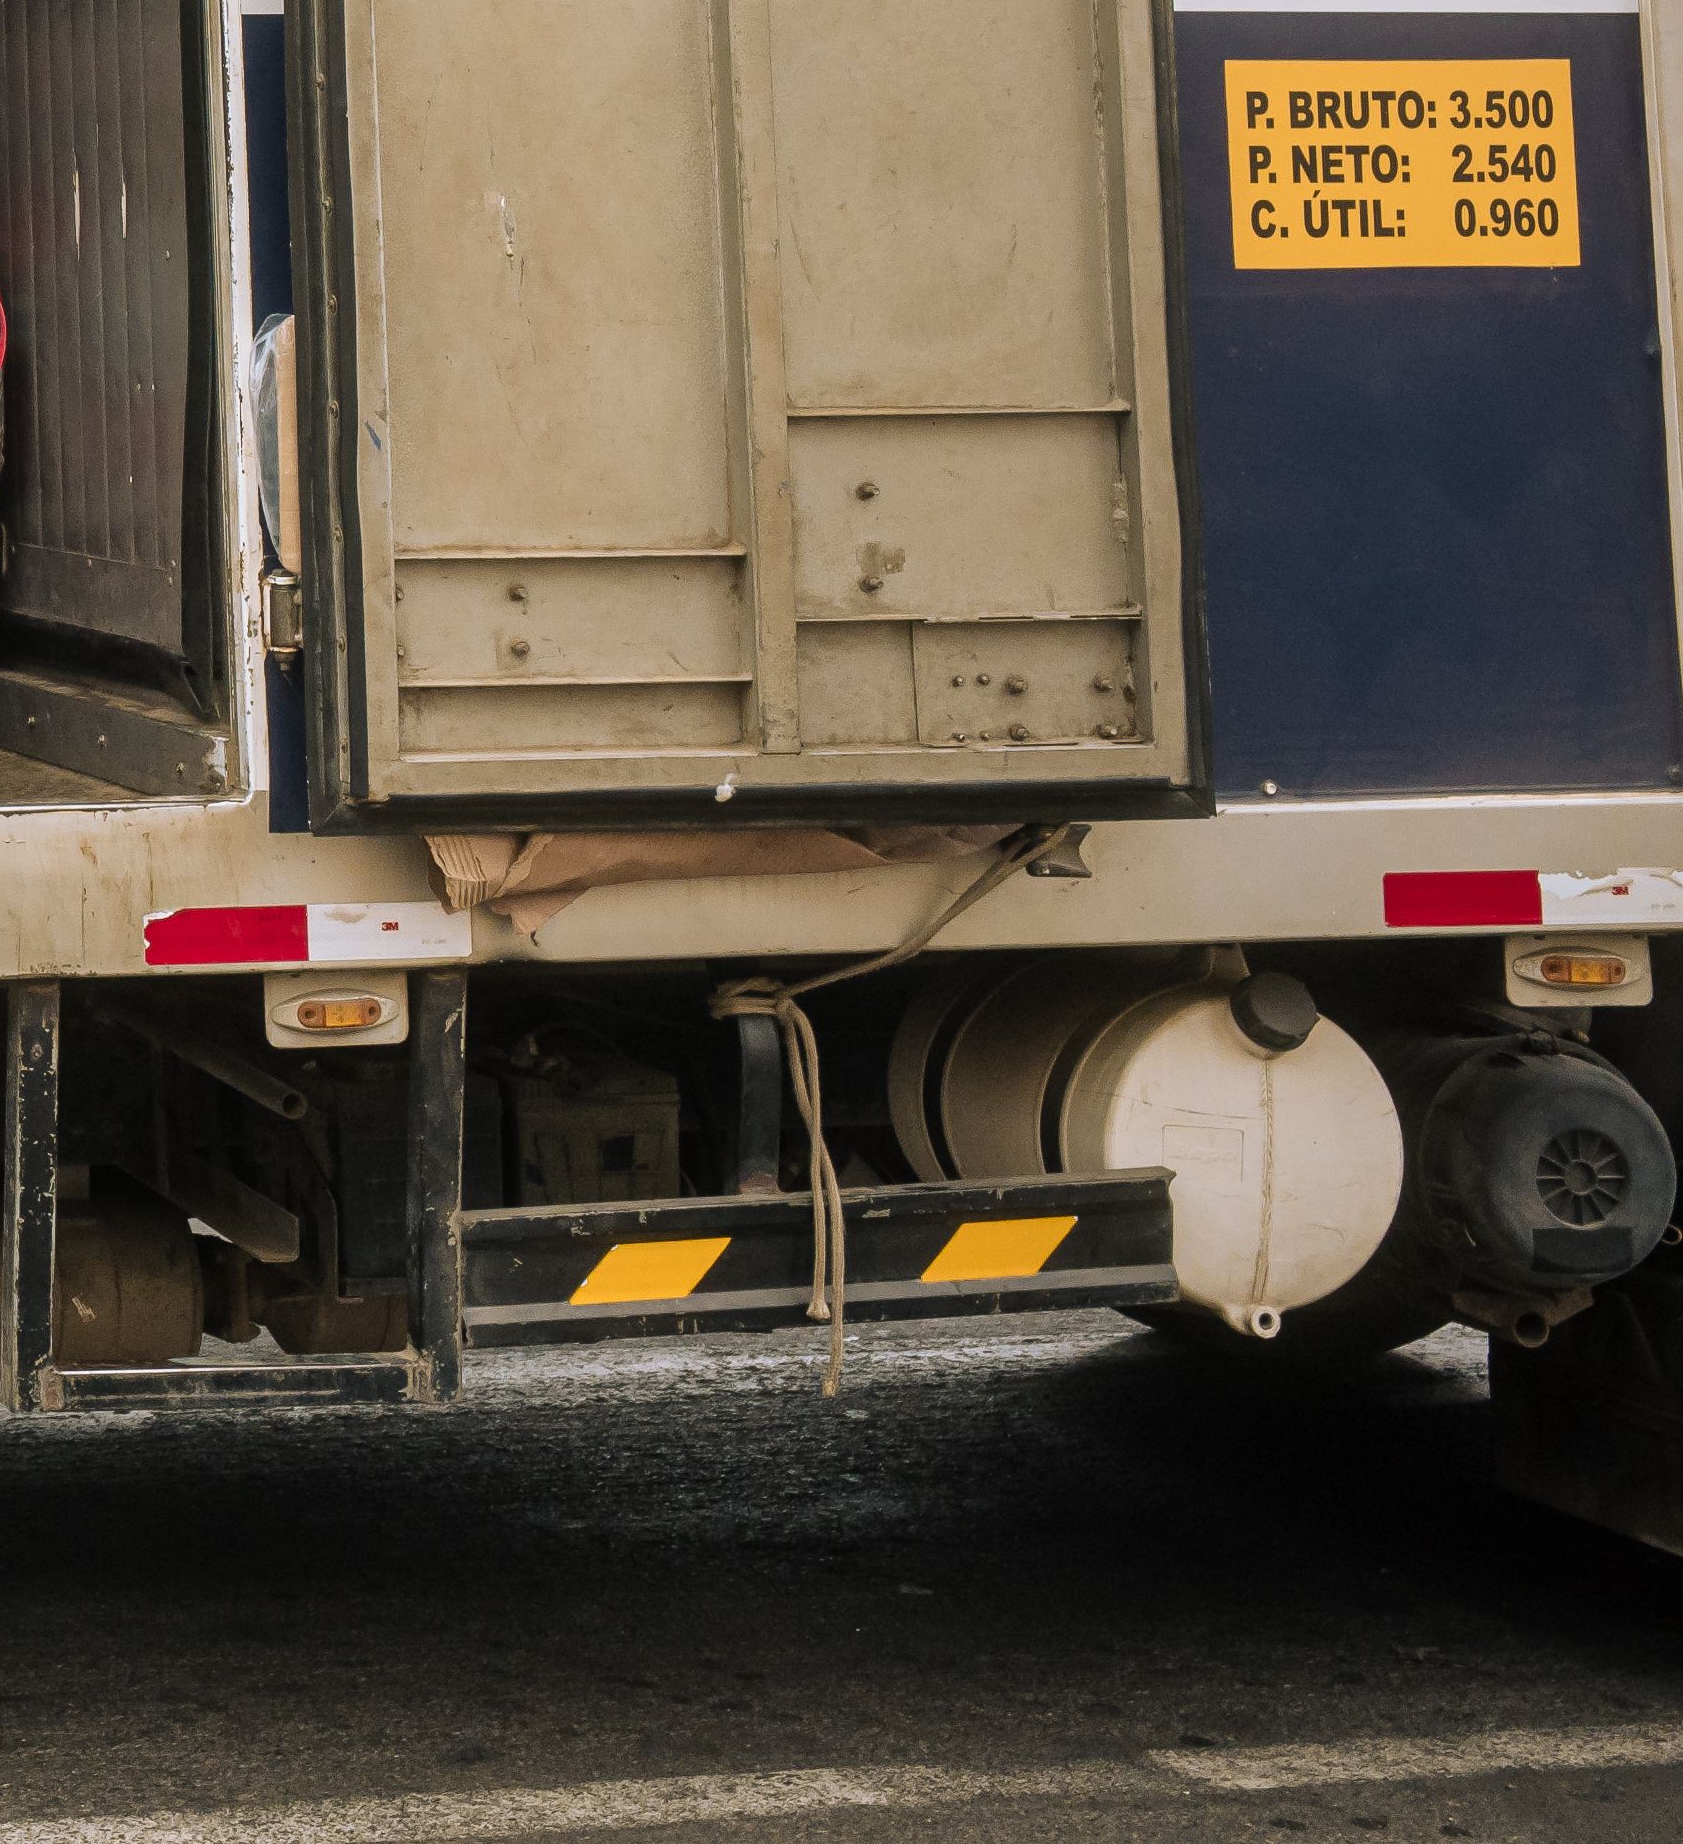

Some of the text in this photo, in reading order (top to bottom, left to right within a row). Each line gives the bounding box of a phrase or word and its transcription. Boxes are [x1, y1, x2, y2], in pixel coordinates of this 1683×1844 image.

[1245, 89, 1554, 130] P. BRUTO: 3.500
[1249, 143, 1557, 184] P. NETO: 2.540
[1250, 189, 1560, 239] C. ÚTIL: 0.960
[381, 922, 399, 931] 3M
